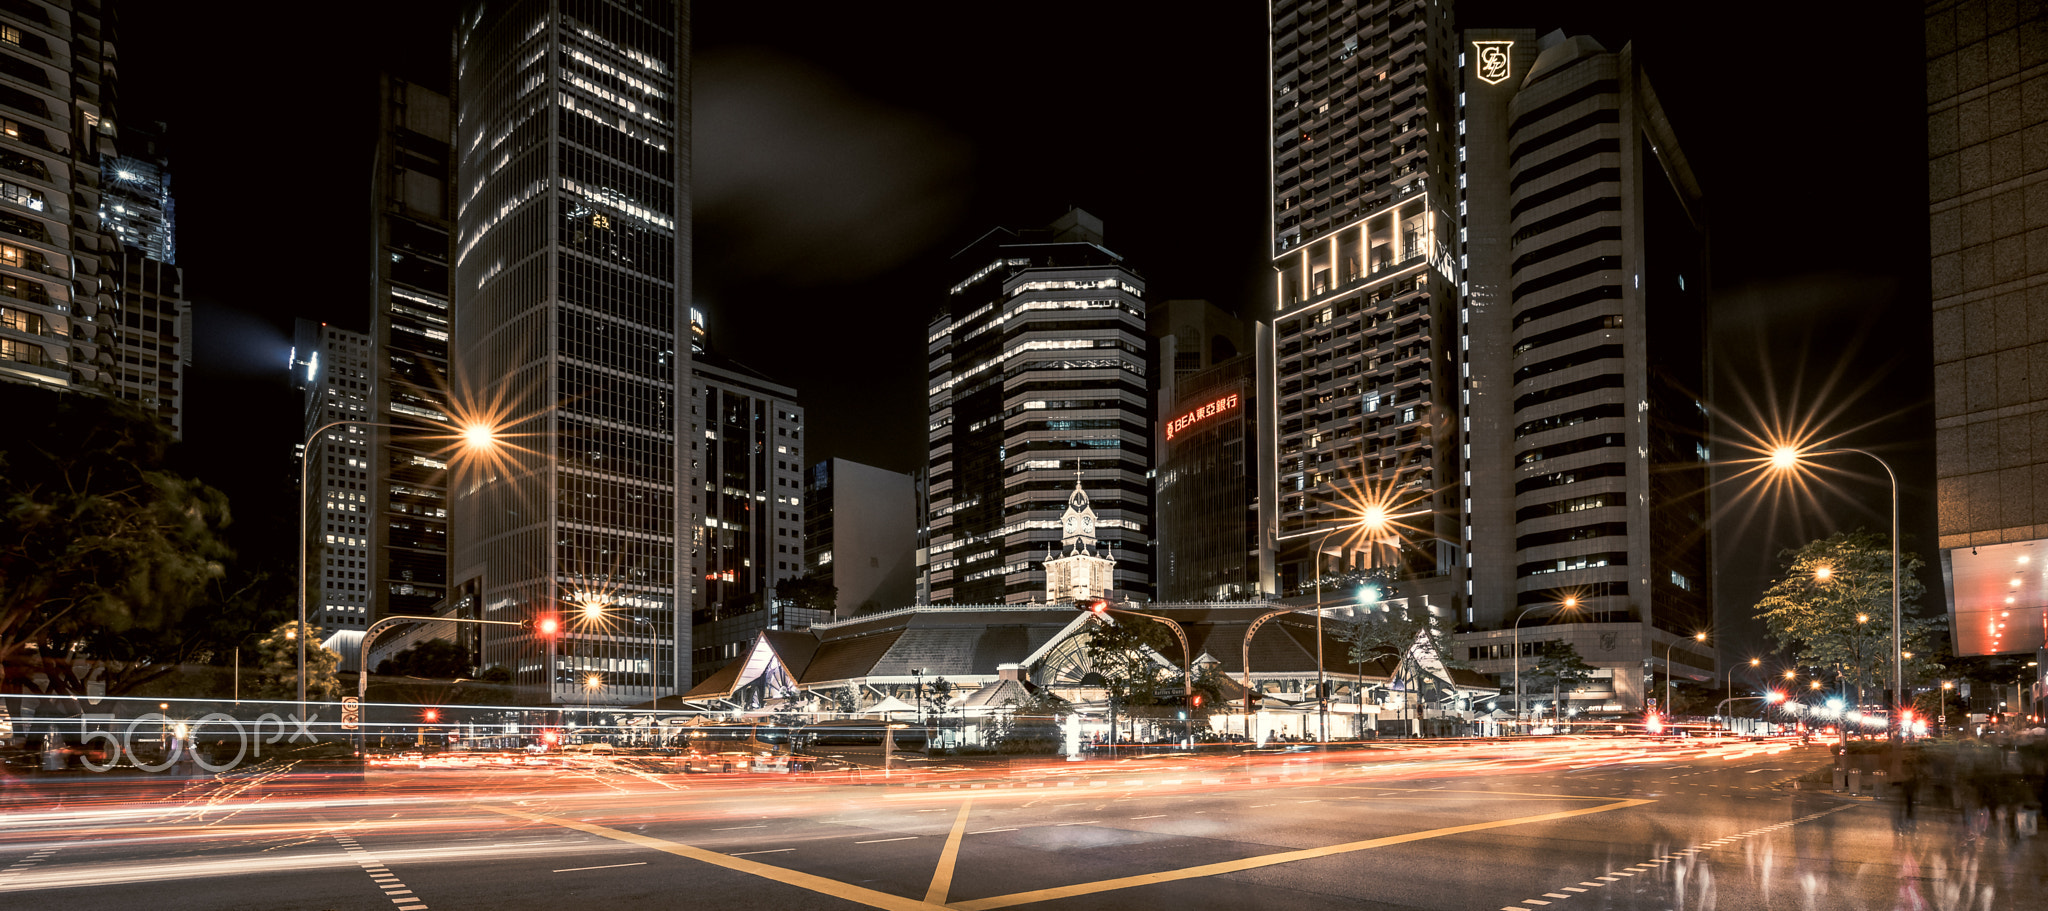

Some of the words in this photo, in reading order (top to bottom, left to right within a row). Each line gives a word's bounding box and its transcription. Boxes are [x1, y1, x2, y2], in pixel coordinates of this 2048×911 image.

[1174, 411, 1196, 433] BEA
[1196, 394, 1238, 421] 東亞銀行
